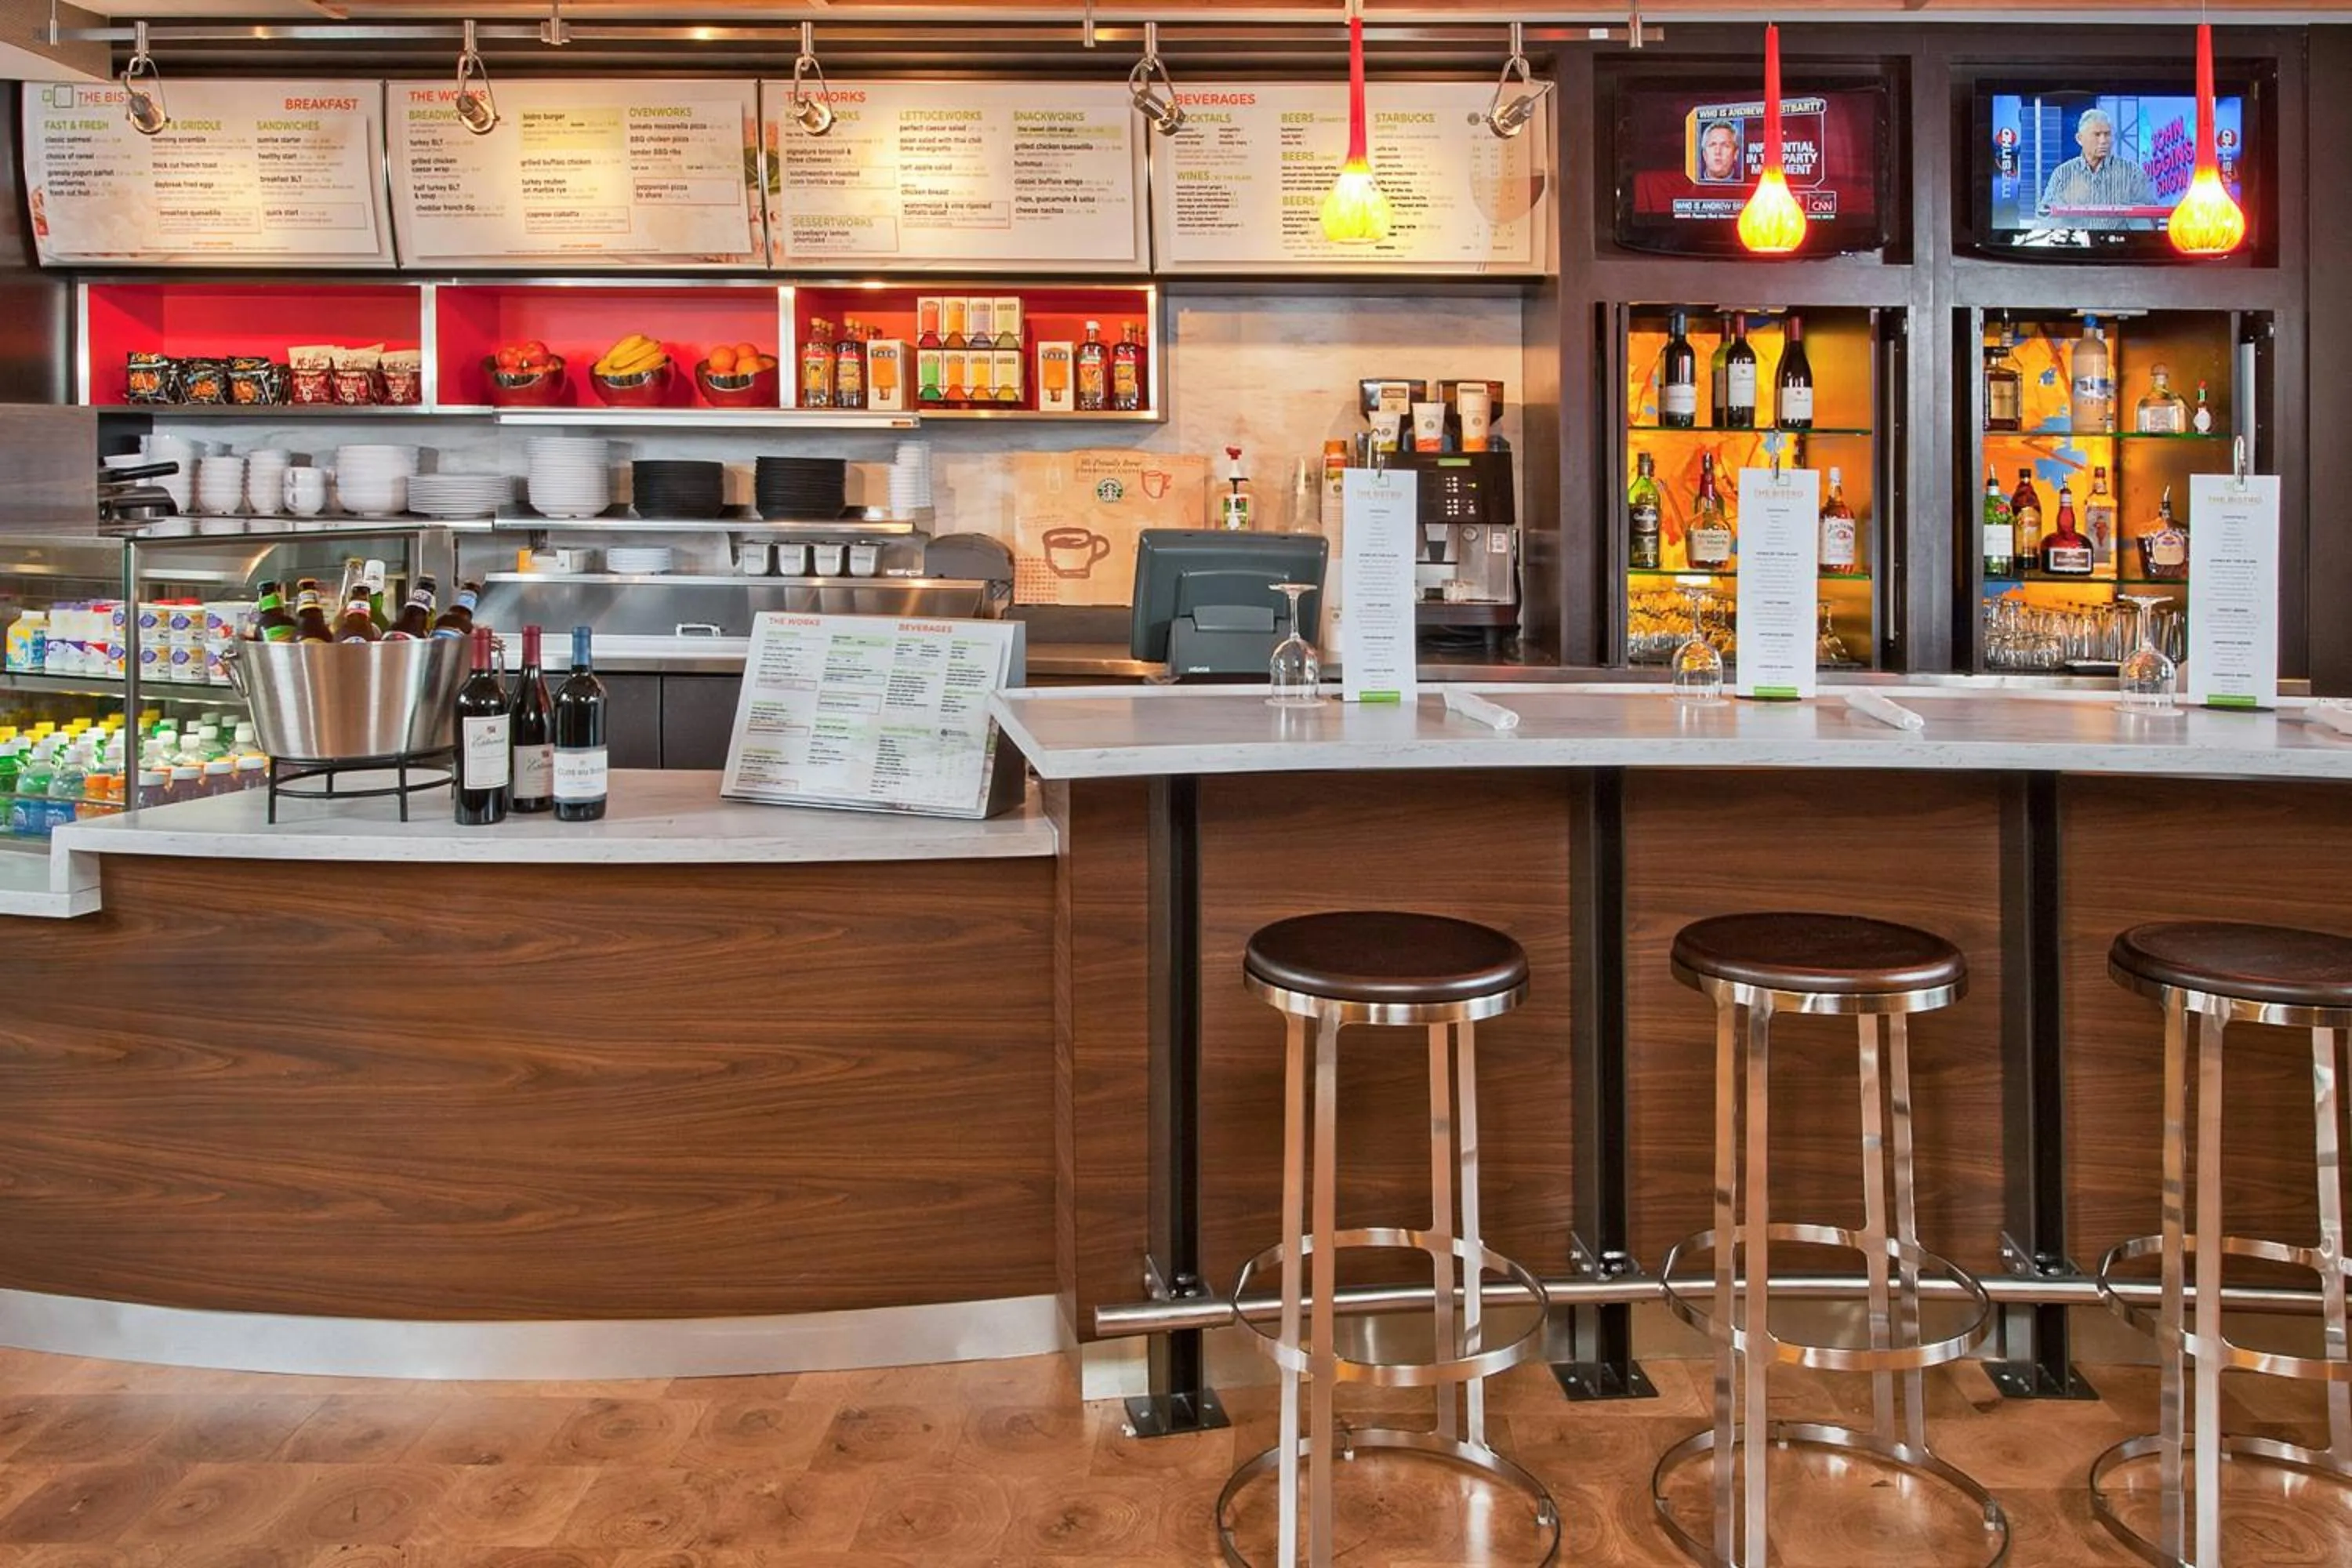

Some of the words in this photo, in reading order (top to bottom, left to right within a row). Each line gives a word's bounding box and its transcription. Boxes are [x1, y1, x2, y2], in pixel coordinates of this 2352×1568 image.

[78, 92, 100, 102] THE
[409, 91, 434, 102] THE
[815, 91, 867, 103] WORKS
[1174, 93, 1255, 104] BEVERAGES
[285, 98, 359, 111] BREAKFAST
[630, 107, 692, 118] OVENWORKS
[899, 111, 982, 121] LETTUCEWORKS
[1014, 111, 1084, 122] SNACKWORKS
[1698, 108, 1718, 118] WHO
[1719, 108, 1727, 117] IS
[1729, 106, 1765, 117] ANDREW
[1183, 113, 1232, 123] OCKTAILS
[1281, 113, 1315, 122] BEERS
[45, 121, 67, 130] FAST
[70, 121, 76, 130] &
[79, 121, 109, 130] FRESH
[180, 120, 221, 130] GRIDDLE
[256, 121, 320, 130] SANDWICHES
[258, 152, 281, 161] healthy
[1281, 151, 1315, 161] BEERS
[1746, 153, 1757, 164] IN
[1781, 152, 1818, 164] PARTY
[1178, 170, 1210, 180] WINES
[1282, 196, 1316, 205] BEERS
[1675, 201, 1692, 210] WHO
[1702, 201, 1732, 210] ANDREW
[1813, 201, 1832, 210] CNN
[793, 217, 873, 227] DESSERTWORKS
[768, 617, 785, 626] THE
[788, 618, 821, 627] WORKS
[898, 623, 953, 633] BEVERAGES
